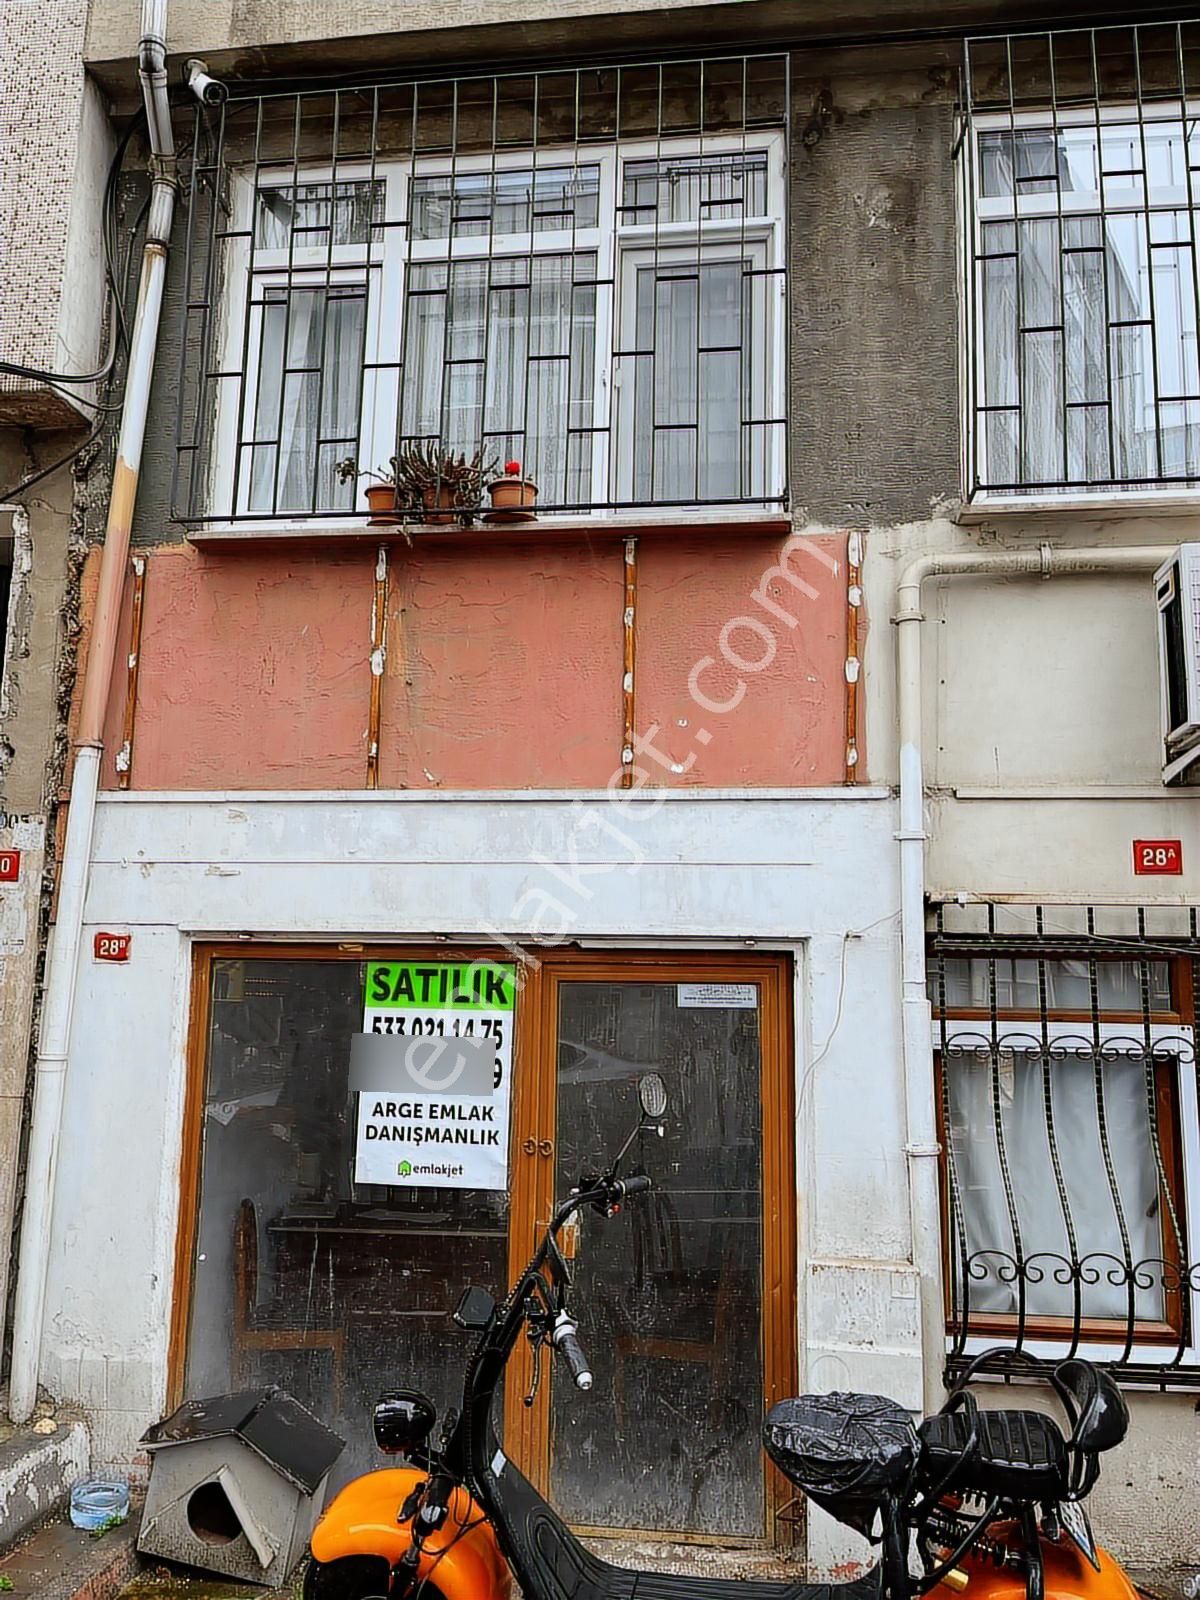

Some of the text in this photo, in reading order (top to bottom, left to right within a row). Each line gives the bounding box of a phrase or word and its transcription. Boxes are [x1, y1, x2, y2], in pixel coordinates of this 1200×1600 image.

[372, 967, 508, 1005] SATILIK
[372, 1102, 494, 1121] ARGE EMLAK
[365, 1124, 500, 1146] DANIŞMANLIK
[413, 1163, 464, 1178] emlakjet
